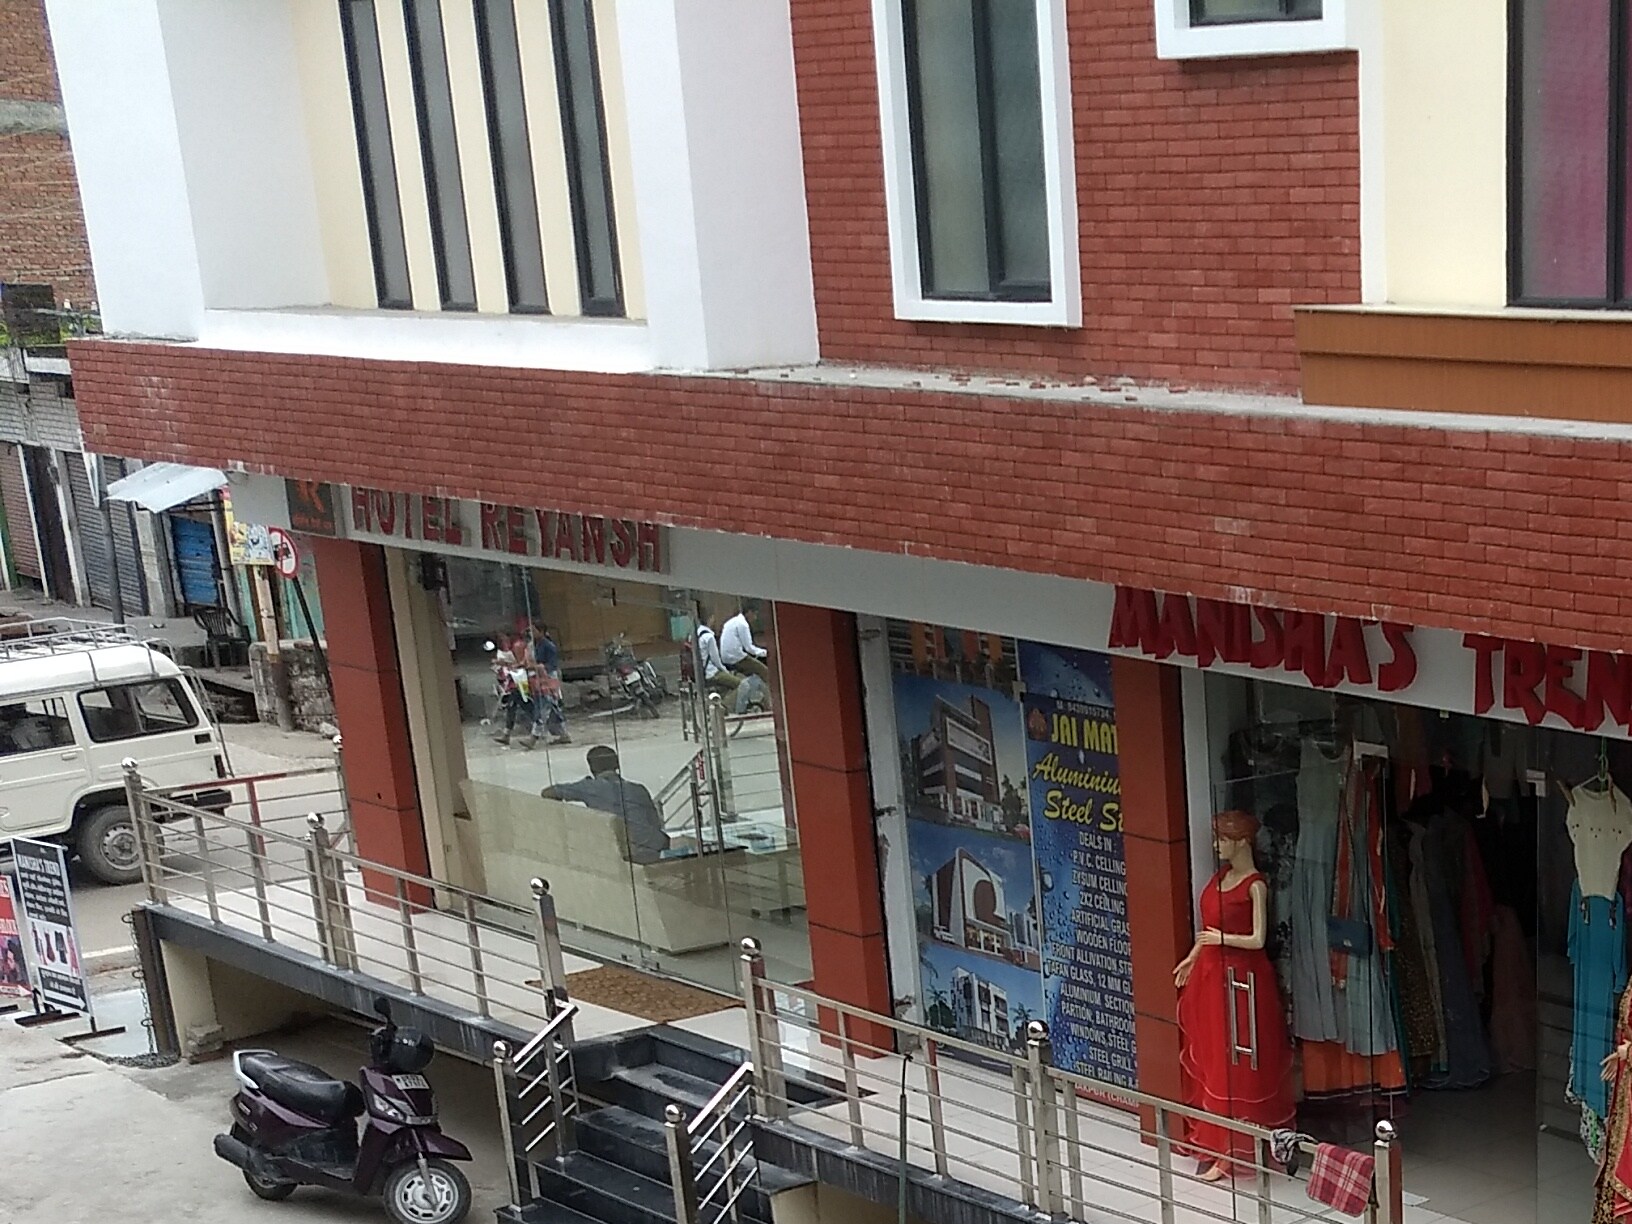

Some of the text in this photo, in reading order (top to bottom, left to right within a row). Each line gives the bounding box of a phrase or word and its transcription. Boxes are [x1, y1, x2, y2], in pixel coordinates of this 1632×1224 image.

[479, 502, 660, 572] REYANSH
[1108, 585, 1417, 691] MANISHA'S
[1051, 713, 1078, 747] JAI
[1044, 790, 1093, 824] Steel
[1079, 831, 1102, 850] DEALS
[1072, 909, 1110, 931] ARTIFICIAL
[1052, 942, 1075, 960] FRONT
[1076, 930, 1108, 953] WOODEN
[1060, 983, 1101, 1006] ALUMINIUM
[1108, 1033, 1129, 1052] STEEL
[1089, 1046, 1110, 1065] STEEL
